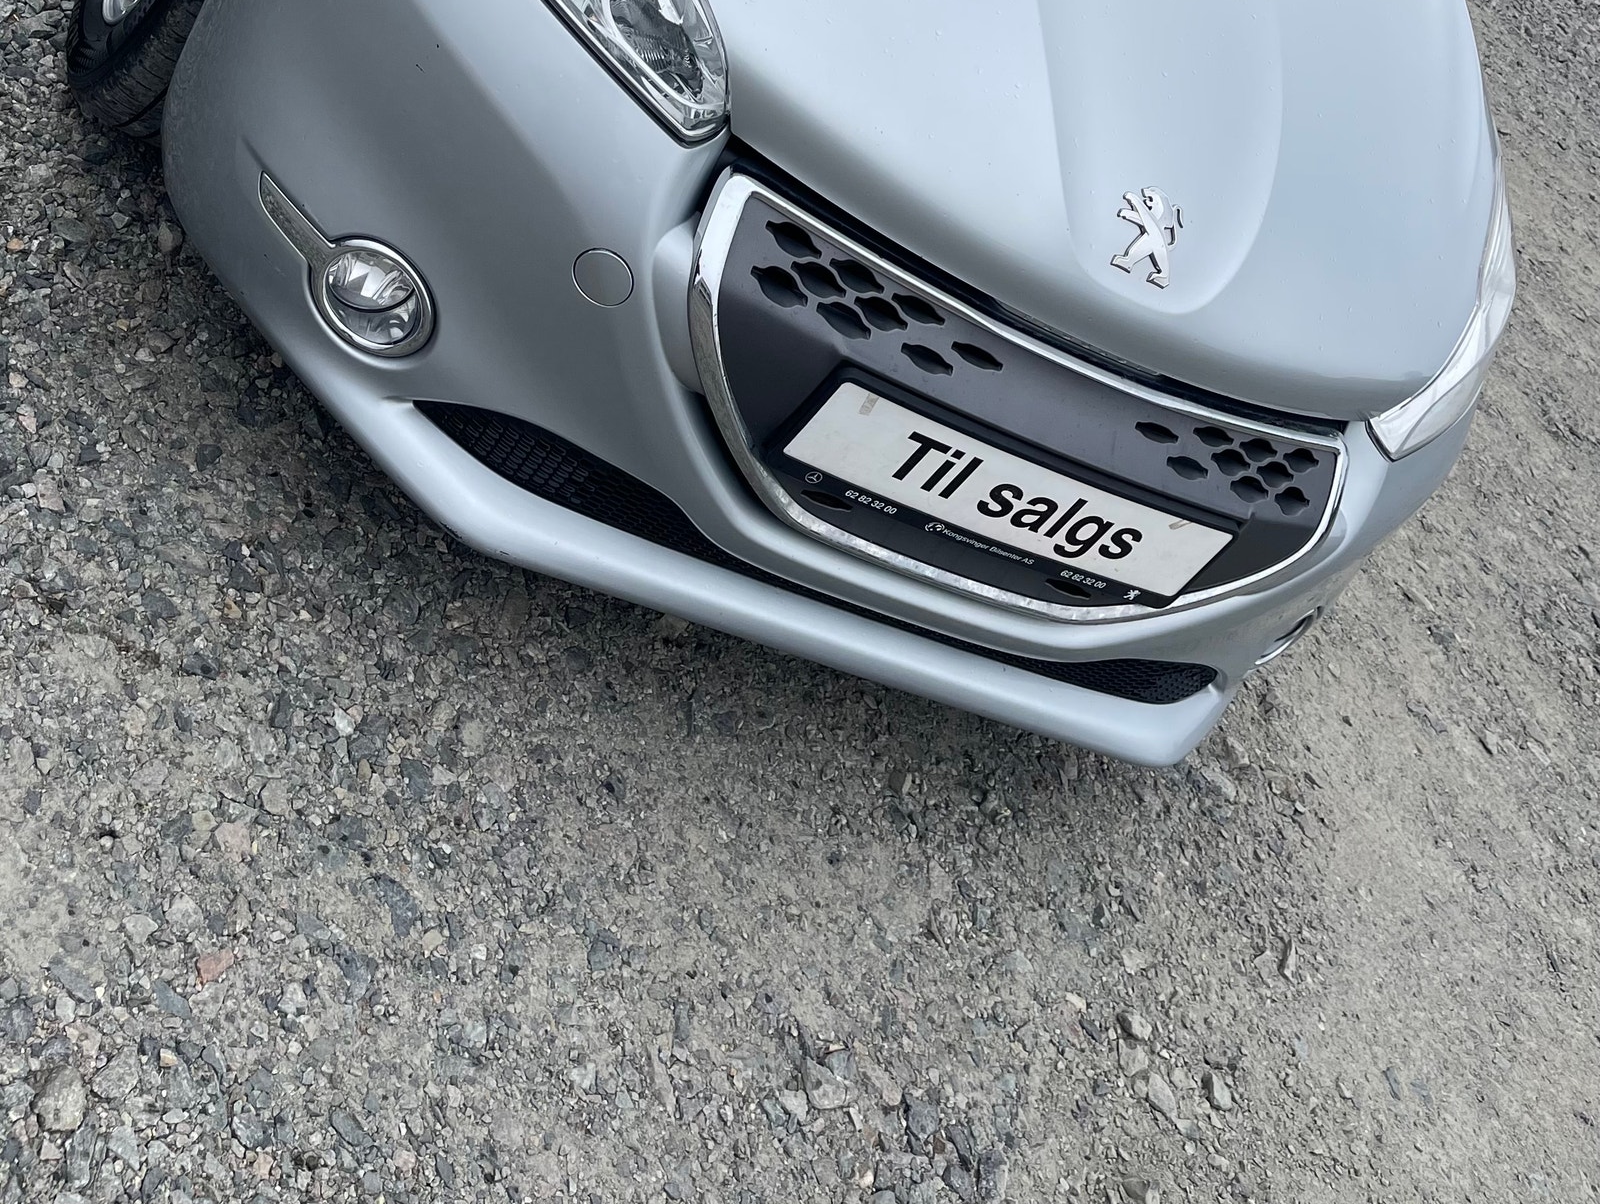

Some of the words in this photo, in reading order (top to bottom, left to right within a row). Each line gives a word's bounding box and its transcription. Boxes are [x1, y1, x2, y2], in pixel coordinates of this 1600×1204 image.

[845, 489, 859, 499] 62
[857, 495, 872, 504] 82
[870, 500, 885, 509] 32
[883, 505, 897, 514] 00
[891, 431, 984, 498] Til
[976, 483, 1143, 559] salgs
[942, 528, 990, 551] Kongsvinger
[1021, 557, 1035, 565] AS
[1060, 569, 1073, 578] 62
[1071, 573, 1084, 582] 82
[1082, 577, 1096, 585] 32
[1093, 581, 1107, 589] 00
